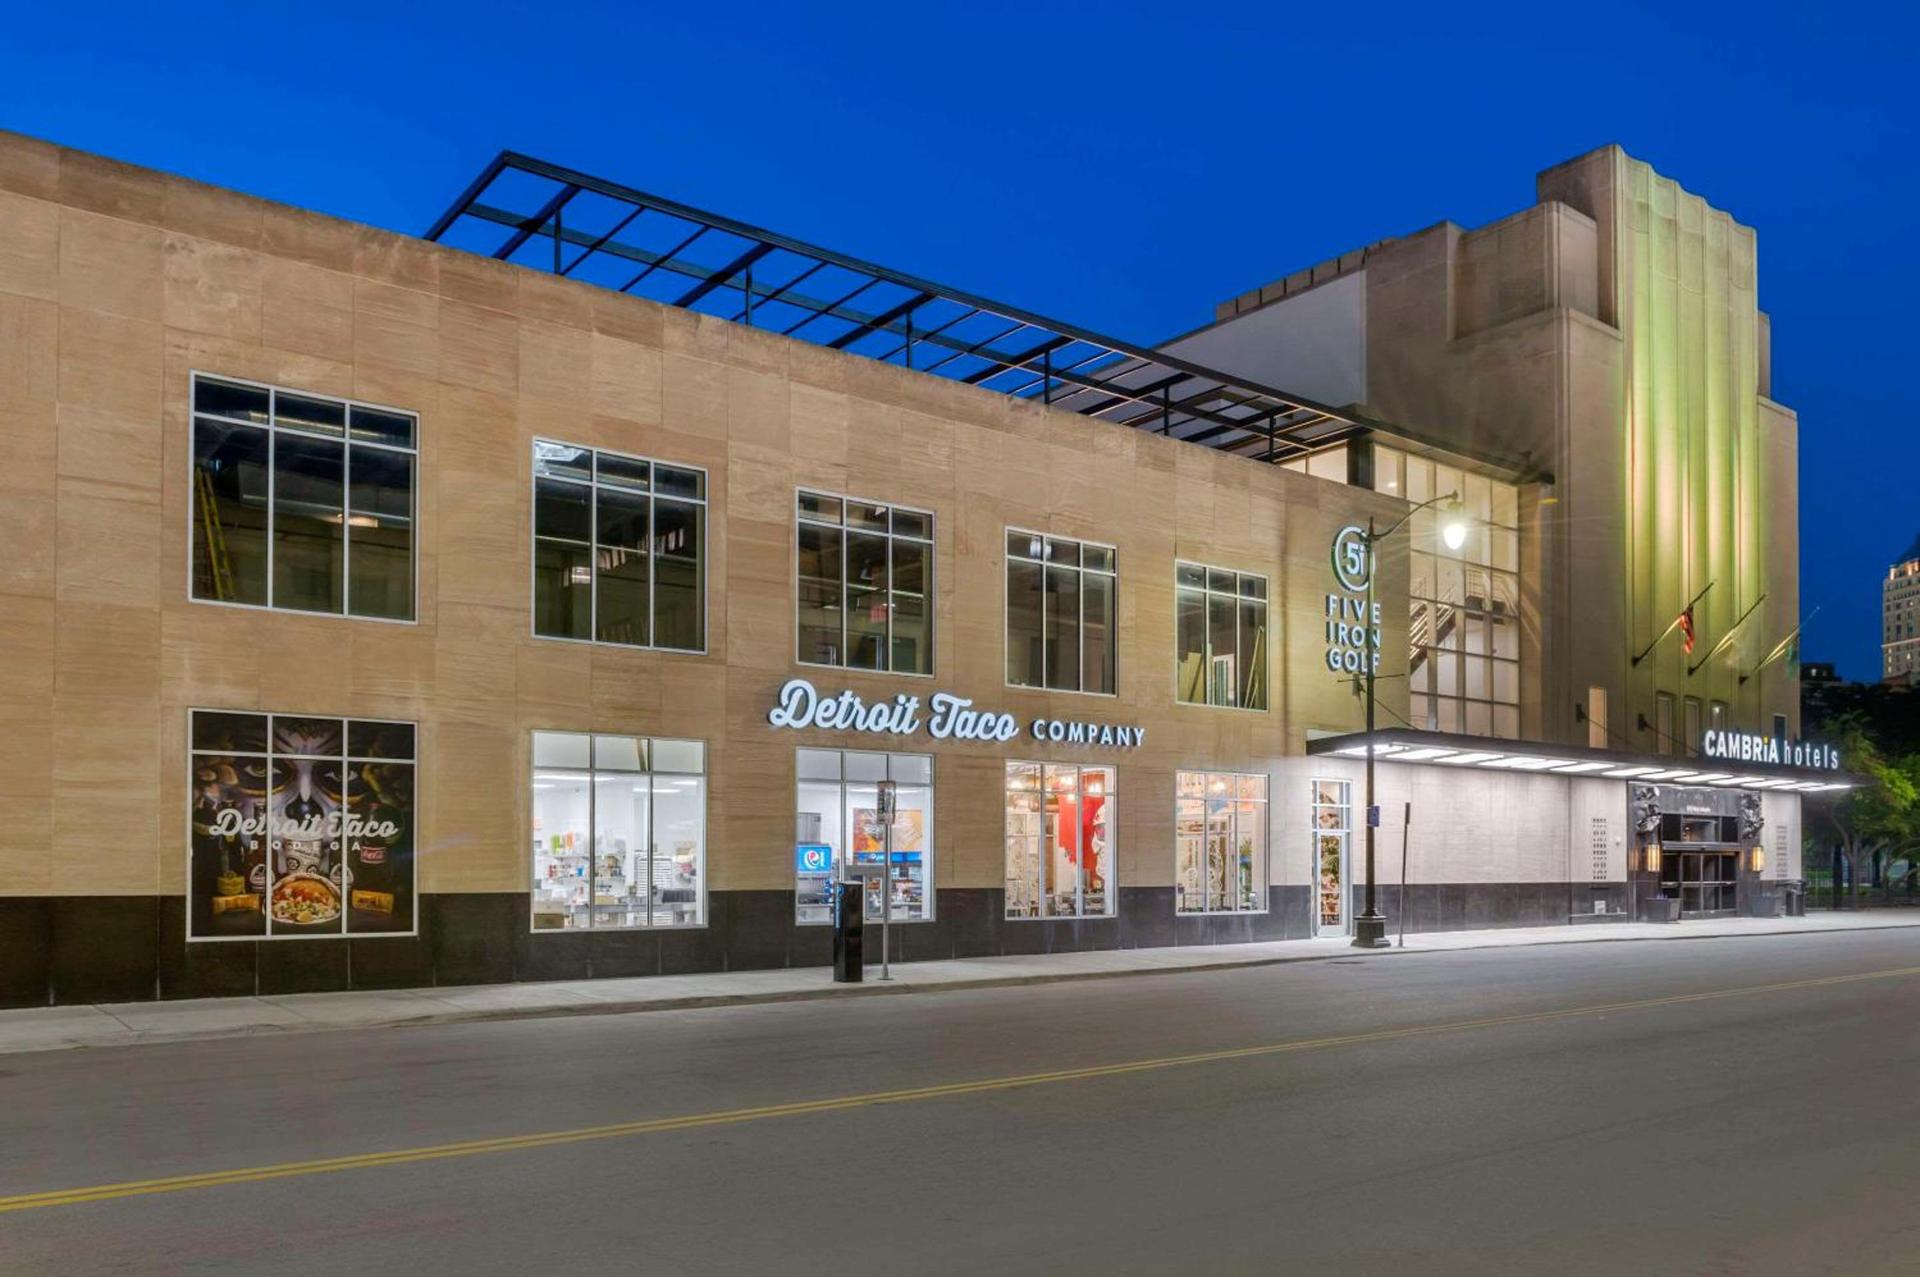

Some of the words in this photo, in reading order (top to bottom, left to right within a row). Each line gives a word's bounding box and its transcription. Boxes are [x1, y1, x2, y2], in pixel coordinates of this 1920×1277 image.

[1328, 594, 1381, 624] FIVE
[1328, 621, 1381, 649] IRON
[1328, 648, 1380, 675] GOLF
[770, 679, 919, 735] Detroit
[929, 693, 1019, 742] Taco
[1031, 718, 1145, 747] COMPANY
[1783, 740, 1839, 769] hotels
[209, 808, 322, 836] Detroit
[328, 811, 398, 837] Taco
[250, 840, 360, 851] BODEGA
